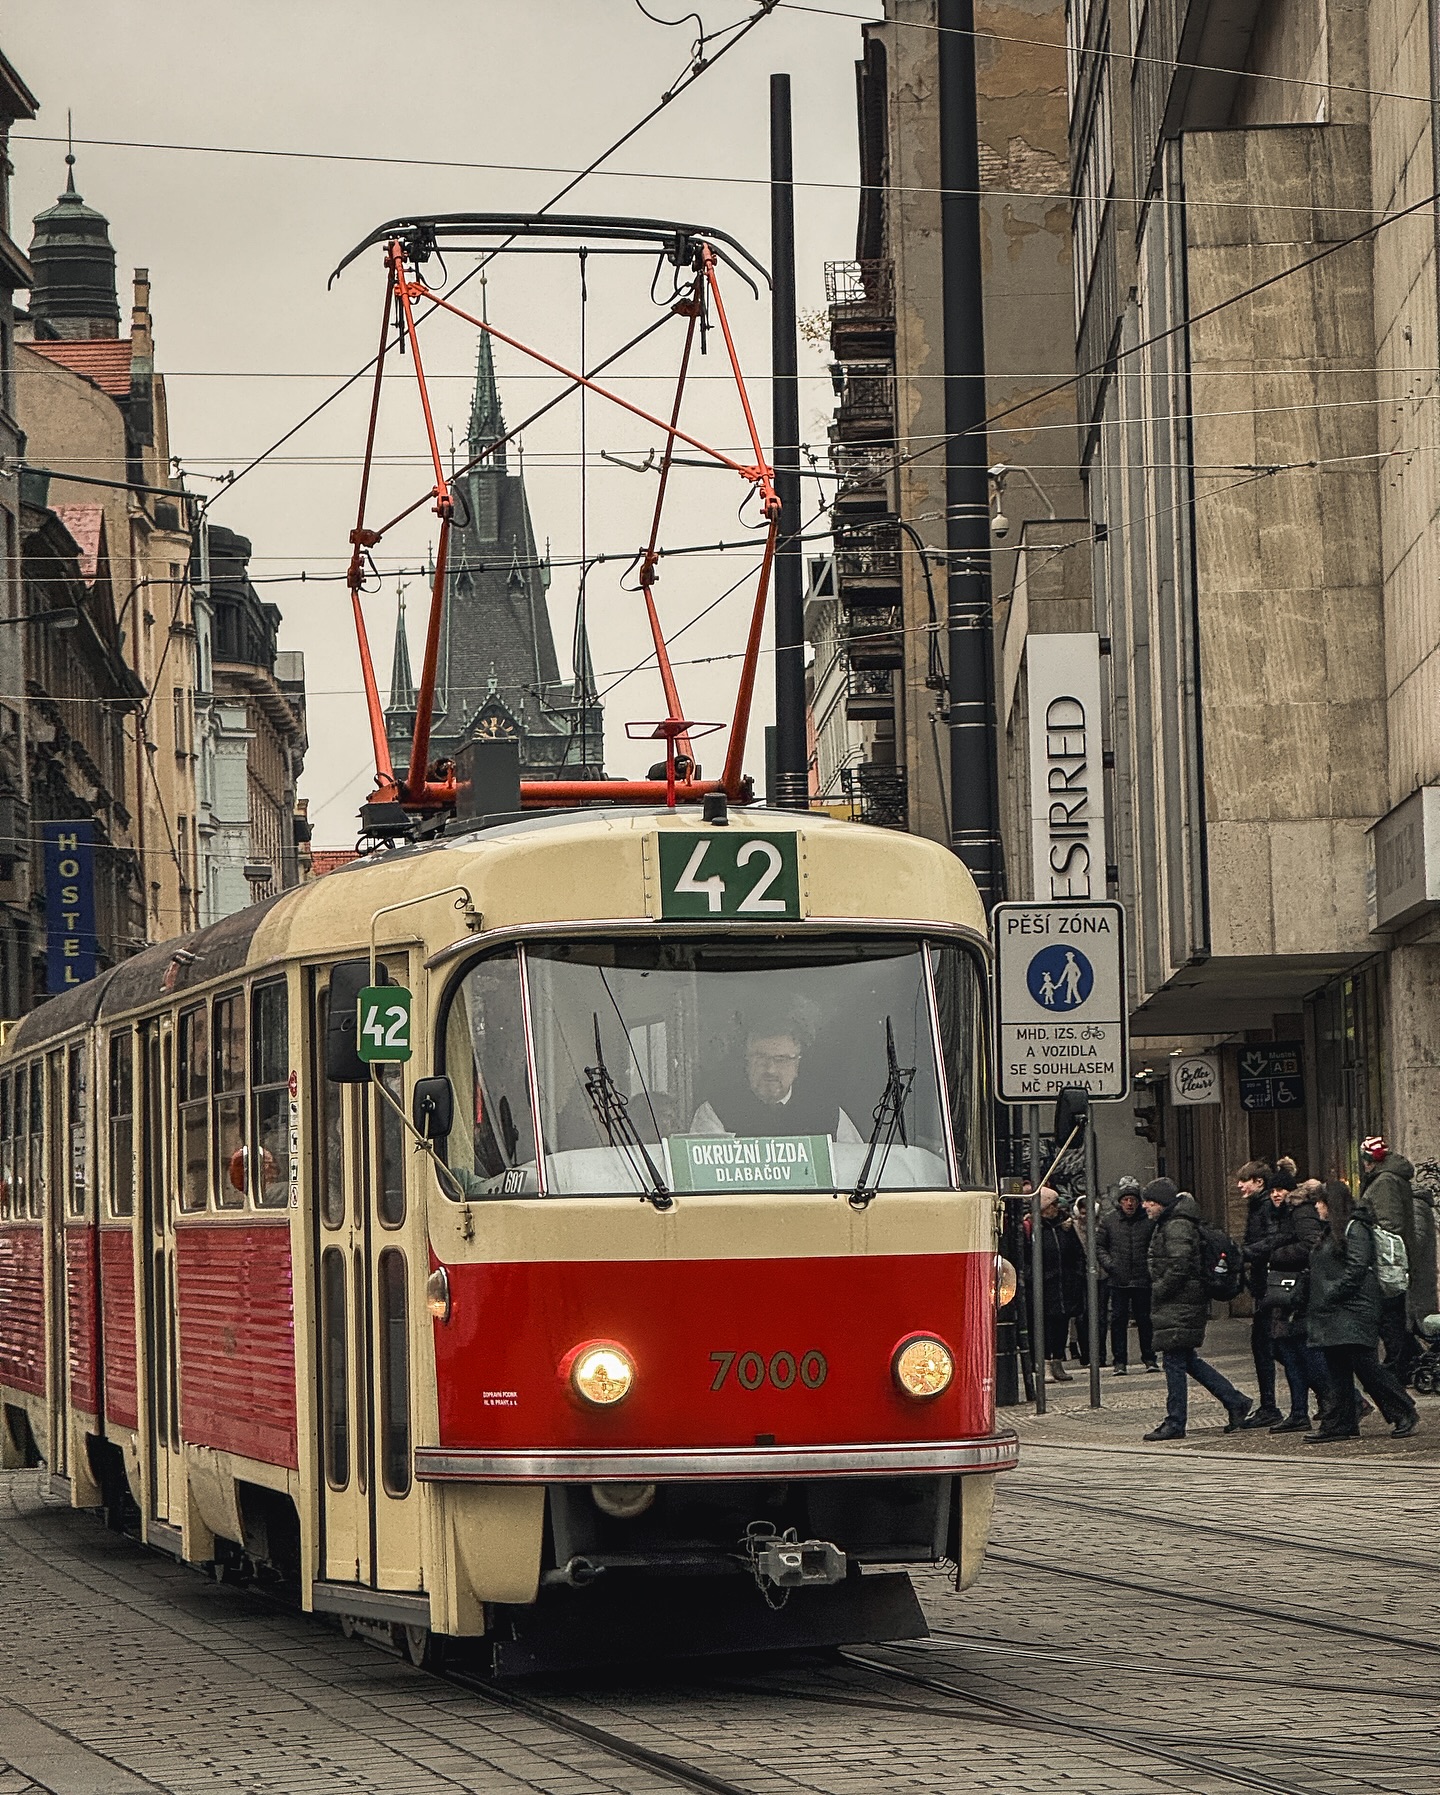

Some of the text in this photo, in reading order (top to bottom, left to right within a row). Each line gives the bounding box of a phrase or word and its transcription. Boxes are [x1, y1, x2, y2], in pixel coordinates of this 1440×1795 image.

[674, 840, 786, 912] 42
[58, 833, 80, 983] HOSTEL
[1007, 913, 1110, 934] PĚŠÍ ZÓNA
[362, 1005, 408, 1046] 42
[1017, 1027, 1077, 1040] MHD. IZS.
[1026, 1045, 1097, 1057] A VOZIDLA
[1010, 1062, 1114, 1075] SE SOUHLASEM
[1274, 1061, 1294, 1072] A B
[1022, 1079, 1040, 1093] MČ
[1098, 1080, 1103, 1091] 1
[692, 1140, 808, 1165] OKRUŽNÍ JÍZDA
[504, 1171, 524, 1193] 601
[716, 1164, 791, 1182] DLABAČOV
[709, 1350, 828, 1391] 7000
